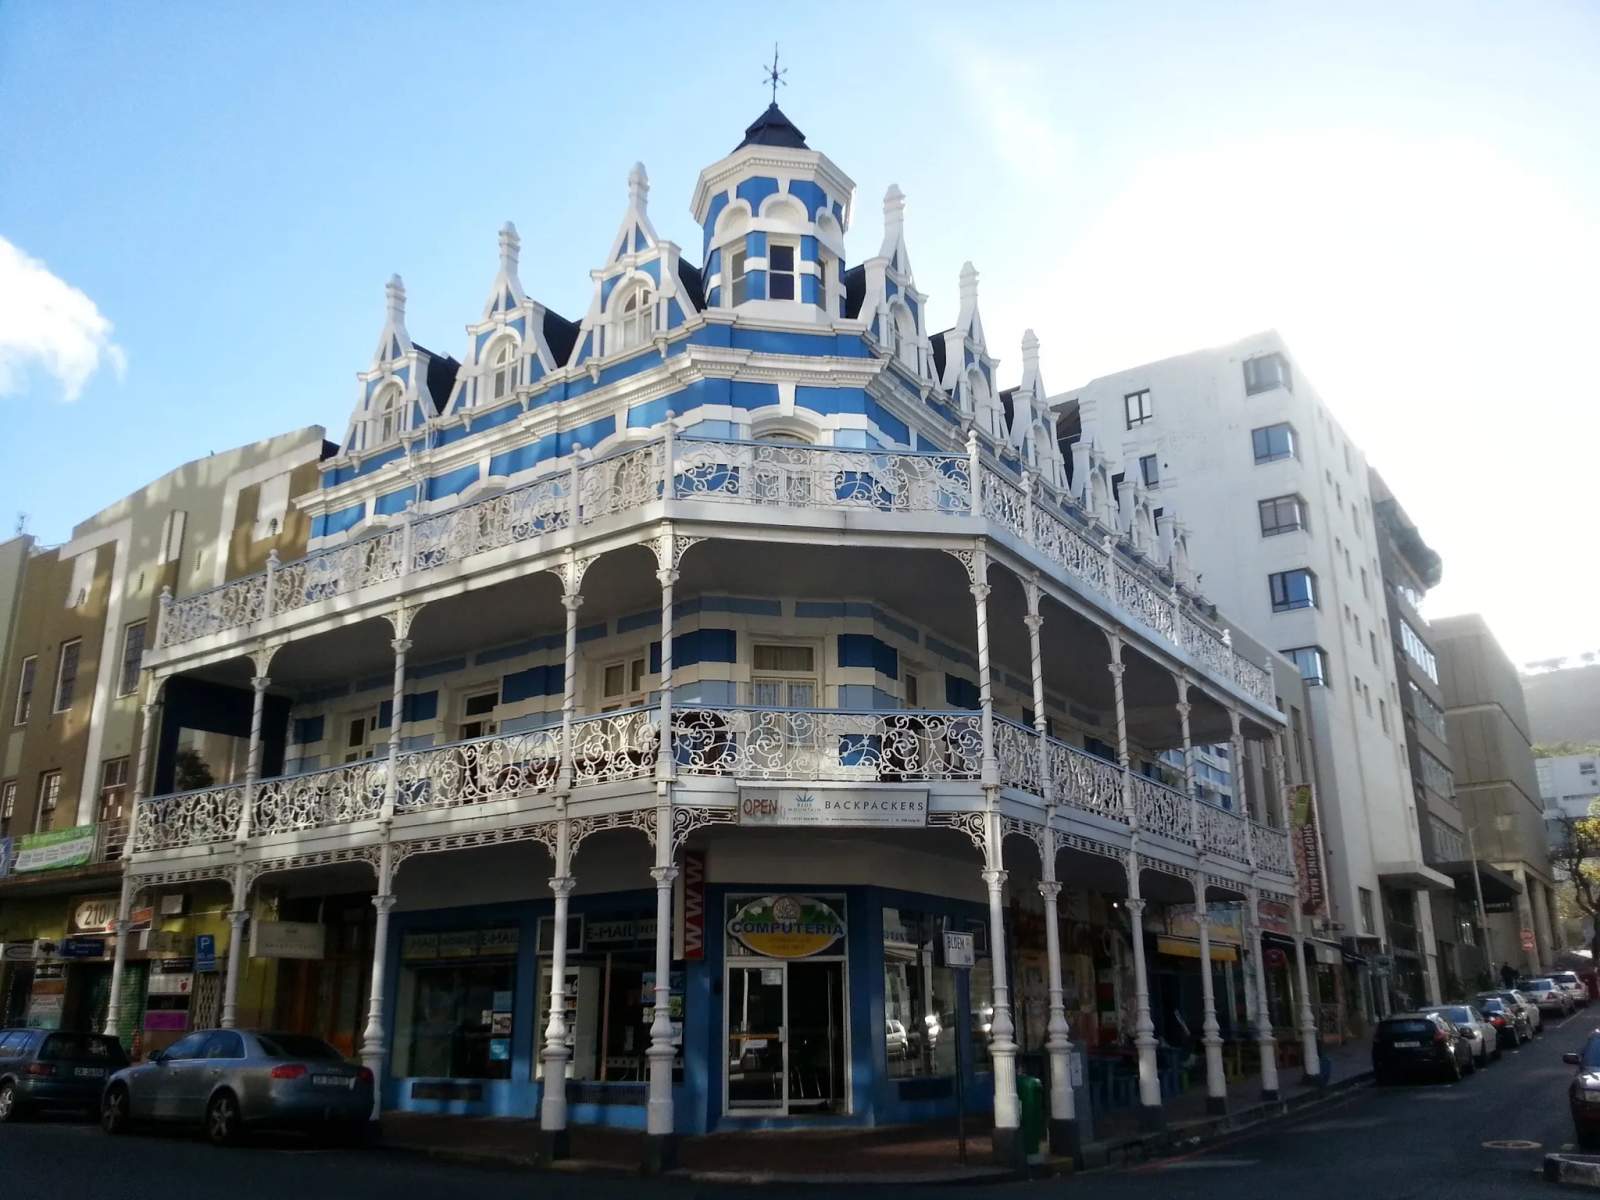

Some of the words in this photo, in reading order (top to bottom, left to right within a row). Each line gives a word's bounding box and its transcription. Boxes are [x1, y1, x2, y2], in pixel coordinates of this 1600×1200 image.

[743, 798, 778, 816] OPEN
[825, 801, 924, 811] BACKPACKERS
[1303, 823, 1317, 876] SHOPPING
[1310, 879, 1321, 905] MALL
[686, 855, 703, 954] WWW
[584, 923, 632, 940] E-MAIL
[730, 921, 844, 935] COMPUTERIA
[200, 936, 210, 949] P
[947, 935, 965, 950] BLOEM
